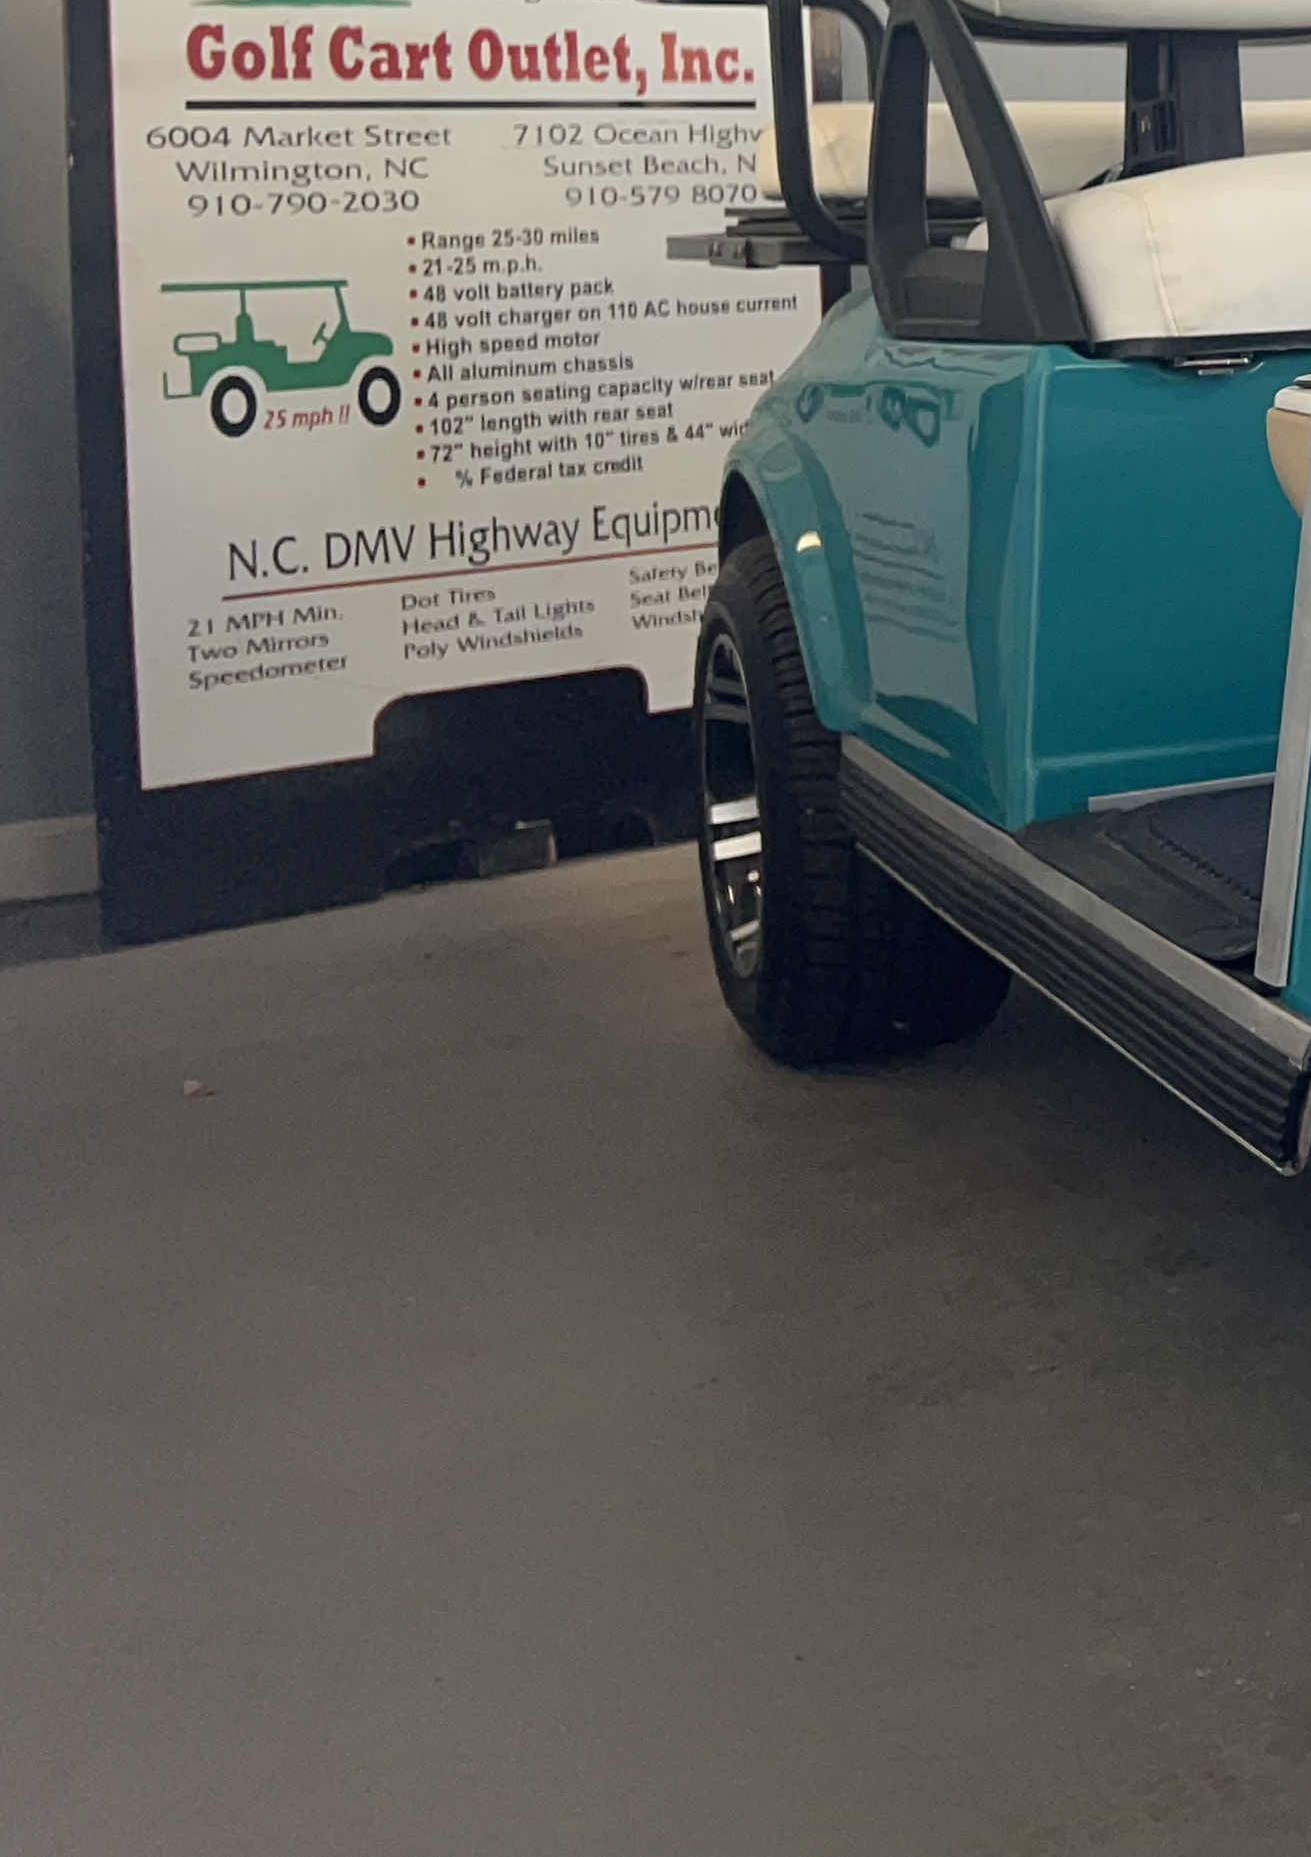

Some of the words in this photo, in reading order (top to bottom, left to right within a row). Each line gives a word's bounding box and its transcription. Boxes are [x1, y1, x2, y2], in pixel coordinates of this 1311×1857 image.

[186, 24, 314, 80] Golf
[328, 26, 452, 81] Cart
[468, 28, 648, 96] Outlet,
[660, 32, 755, 84] Inc.
[146, 126, 232, 148] 6004
[243, 125, 356, 148] Market
[364, 124, 452, 147] Street
[512, 122, 585, 146] 7102
[593, 122, 678, 146] Ocean
[174, 159, 371, 187] Wilmington,
[384, 157, 430, 179] NC
[543, 154, 633, 176] Sunset
[643, 153, 727, 175] Beach,
[187, 189, 420, 217] 910-790-2030
[565, 183, 681, 207] 910-579
[691, 183, 757, 205] 8070
[421, 230, 486, 253] Range
[491, 227, 545, 248] 25-30
[550, 225, 600, 245] miles
[422, 255, 476, 277] 21-25
[482, 252, 543, 275] m.p.h.
[423, 283, 447, 303] 48
[453, 282, 491, 301] volt
[496, 280, 564, 302] battery
[569, 277, 614, 300] pack
[424, 311, 448, 330] 48
[455, 308, 492, 328] volt
[497, 306, 572, 328] charger
[577, 305, 602, 322] on
[608, 300, 638, 320] 110
[643, 298, 671, 319] AC
[676, 297, 731, 316] house
[736, 292, 798, 314] current
[425, 335, 472, 359] High
[479, 332, 539, 355] speed
[544, 330, 600, 350] motor
[427, 362, 454, 383] All
[460, 359, 557, 381] aluminum
[563, 351, 635, 374] chassis
[427, 391, 440, 409] 4
[446, 389, 516, 412] person
[521, 382, 592, 404] seating
[597, 376, 674, 400] capacity
[679, 372, 733, 391] w/rear
[738, 369, 775, 389] seat
[263, 407, 287, 431] 25
[291, 404, 334, 433] mph
[480, 411, 542, 435] length
[548, 407, 588, 428] with
[593, 405, 630, 424] rear
[635, 401, 674, 422] seat
[470, 437, 533, 463] height
[538, 434, 578, 454] with
[620, 427, 660, 448] tires
[666, 423, 679, 444] &
[455, 467, 474, 489] %
[480, 460, 552, 486] Federal
[558, 461, 587, 479] tax
[593, 453, 644, 476] credit
[229, 536, 309, 580] N.C.
[325, 522, 416, 571] DMV
[428, 516, 581, 567] Highway
[629, 564, 689, 585] Safety
[401, 591, 441, 611] Dot
[448, 586, 497, 606] Tires
[630, 588, 671, 609] Seat
[225, 608, 285, 633] MPH
[291, 603, 344, 625] Min.
[402, 613, 461, 637] Head
[467, 608, 486, 629] &
[492, 604, 528, 625] Tail
[533, 597, 596, 622] Lights
[187, 643, 239, 663] Two
[246, 633, 329, 656] Mirrors
[403, 641, 451, 662] Poly
[456, 622, 584, 654] Windshields
[188, 655, 348, 690] Speedometer
